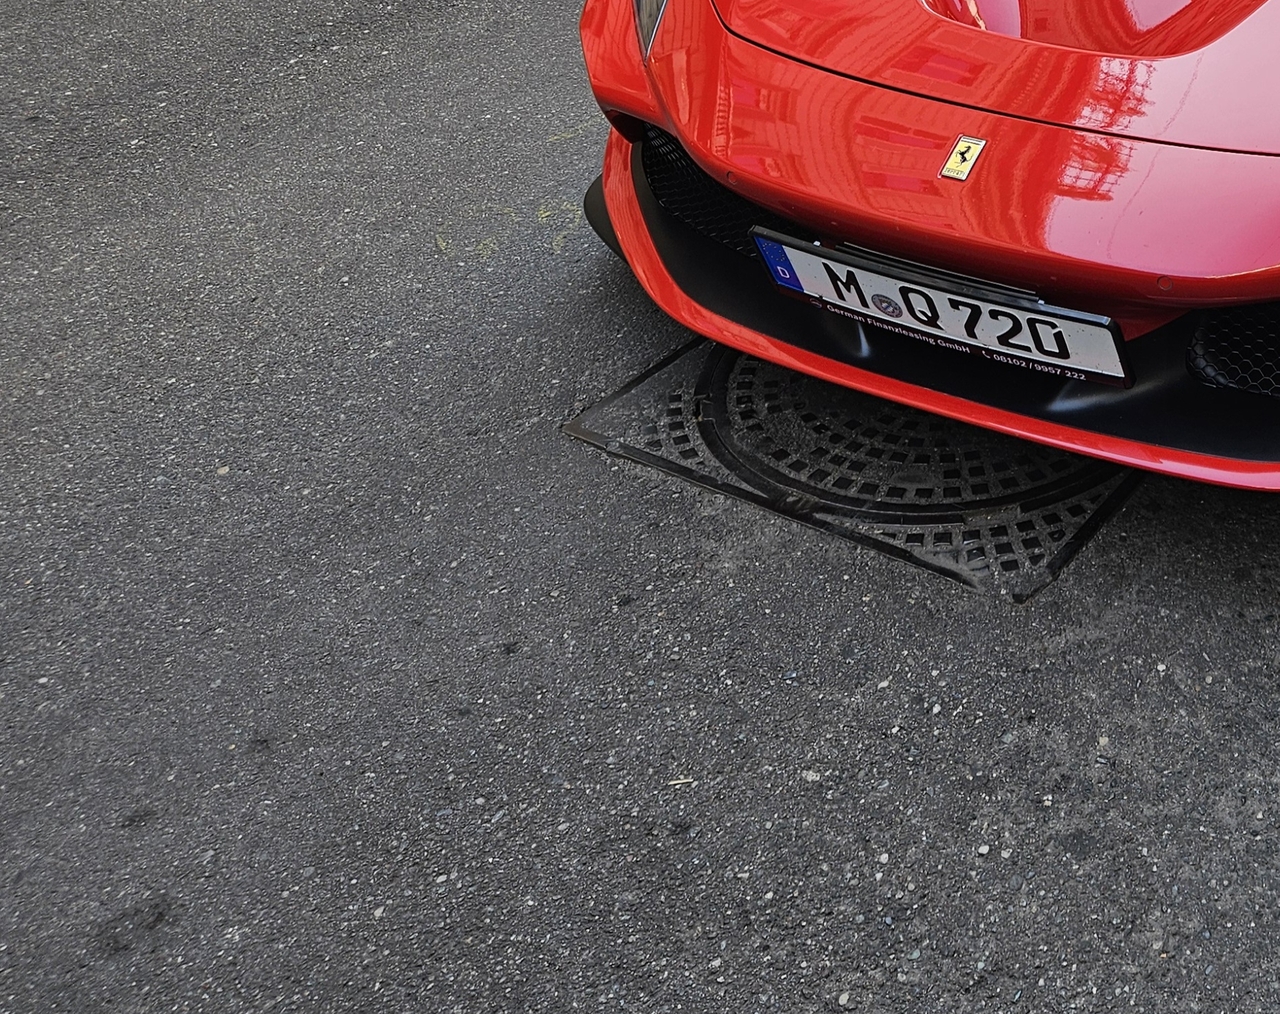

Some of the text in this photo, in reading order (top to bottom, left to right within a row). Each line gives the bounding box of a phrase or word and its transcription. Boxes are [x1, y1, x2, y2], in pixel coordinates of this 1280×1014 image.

[777, 266, 790, 279] D
[822, 262, 1071, 360] M Q 720
[826, 304, 971, 354] German Finanzleasing GmbH
[993, 354, 1027, 368] 08102
[1034, 364, 1061, 376] 9957
[1064, 370, 1087, 381] 222
